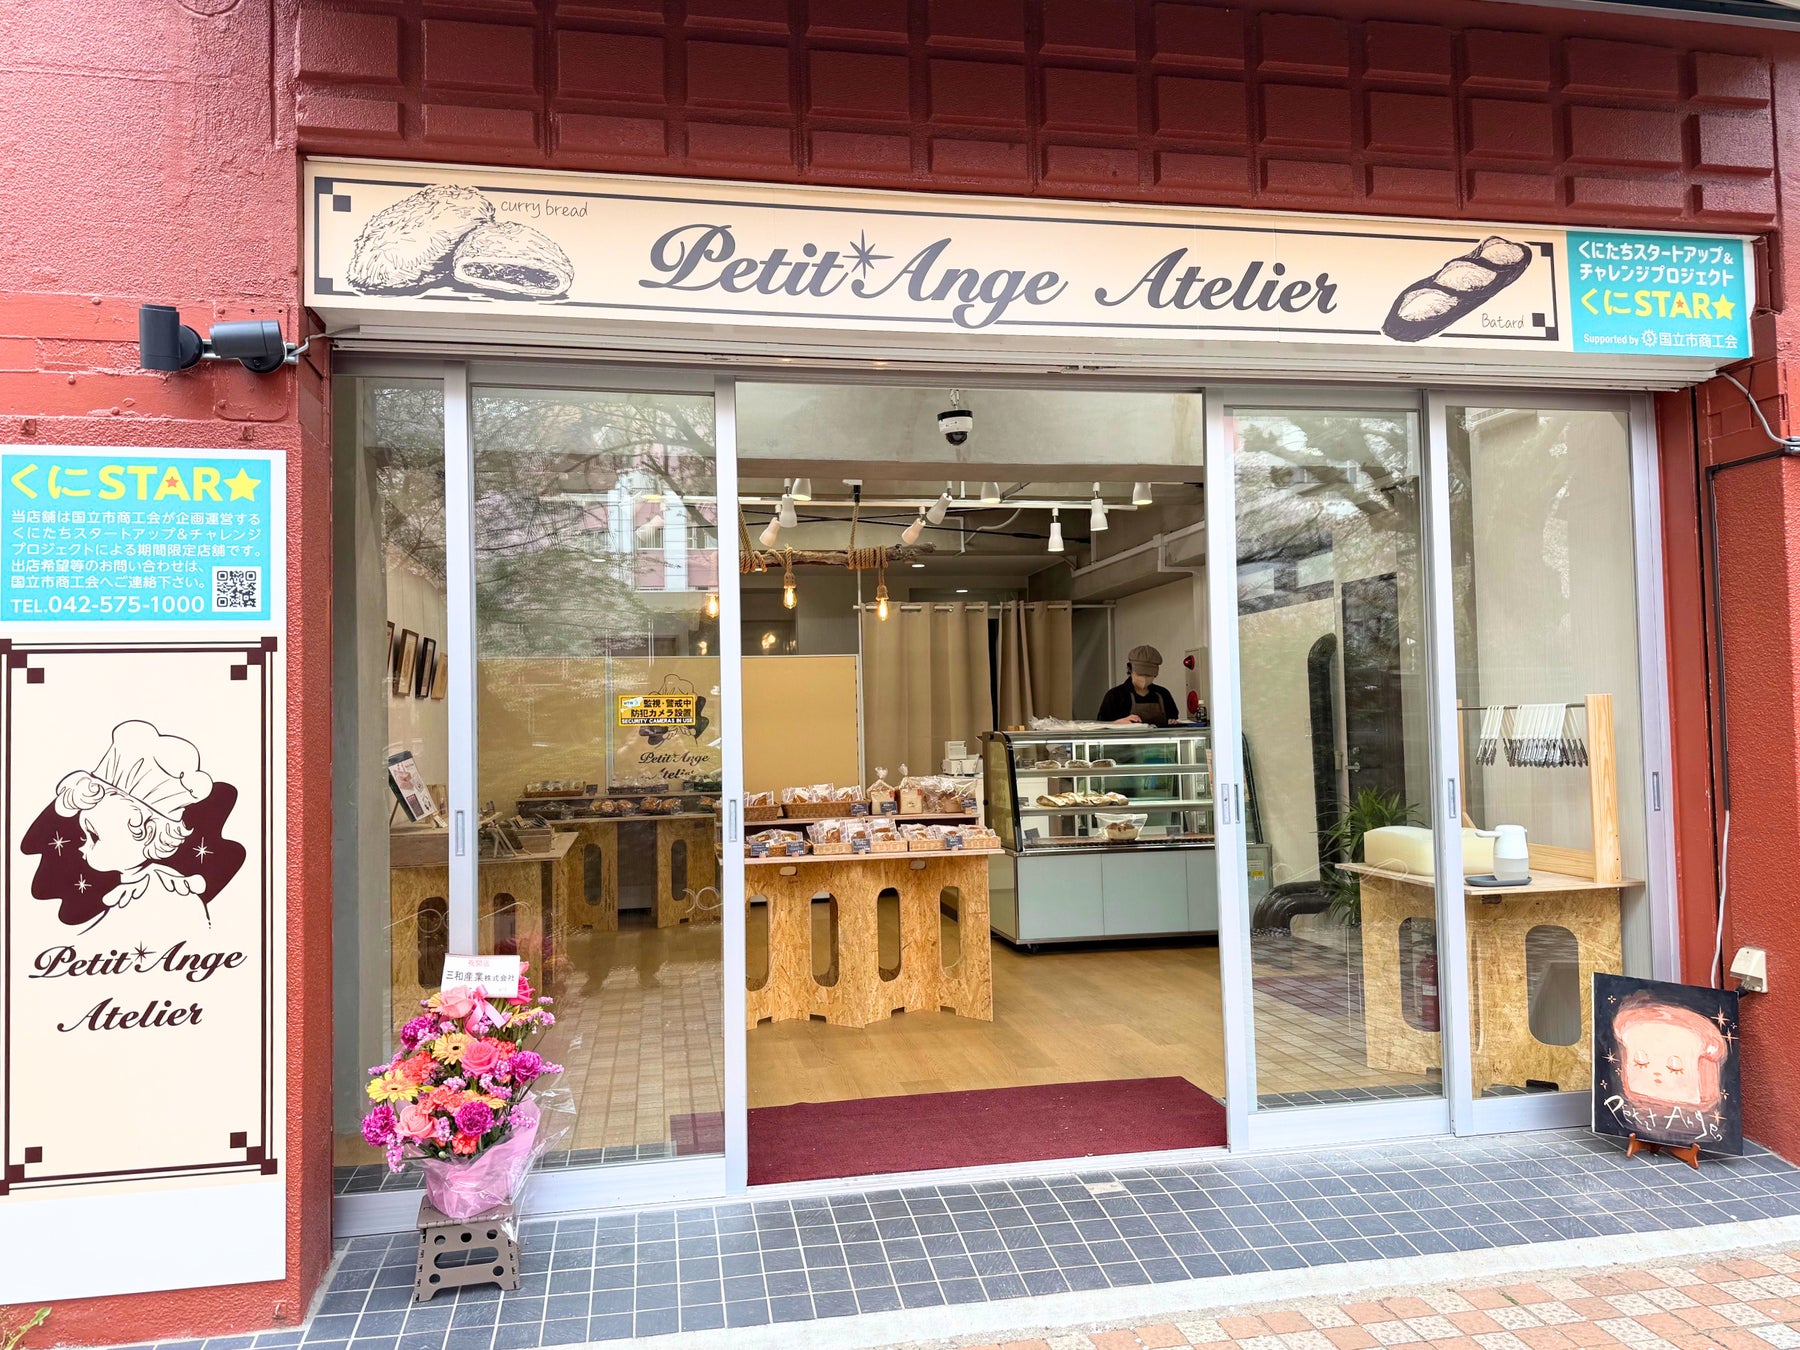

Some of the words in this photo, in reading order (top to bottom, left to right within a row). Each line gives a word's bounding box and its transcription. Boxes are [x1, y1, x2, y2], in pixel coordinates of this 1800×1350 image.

[500, 201, 541, 218] curry
[545, 199, 588, 218] bread
[638, 224, 848, 297] Petit
[853, 237, 1068, 329] Ange
[1095, 247, 1338, 314] Atelier
[1579, 263, 1734, 287] チャレンジプロジェクト
[1481, 312, 1524, 329] Batard
[1583, 333, 1627, 345] Supported
[1628, 334, 1639, 345] by
[1659, 332, 1738, 349] 国立市商工会
[11, 510, 261, 526] 当店舗は国立市商工会が企画運営する
[11, 526, 262, 541] くにたちスタートアップ&チャレンジ
[11, 542, 261, 557] プロジェクトによる期間限定店舗です。
[11, 559, 205, 573] 出店希望等のお問い合わせは、
[11, 575, 205, 589] 国立市商工会へご連絡下さい。
[631, 709, 691, 717] 防犯カメラ設置
[638, 752, 672, 764] Petit
[673, 751, 710, 766] Ange
[28, 945, 133, 979] Petit
[134, 941, 248, 982] Ange
[57, 997, 203, 1032] Atelier
